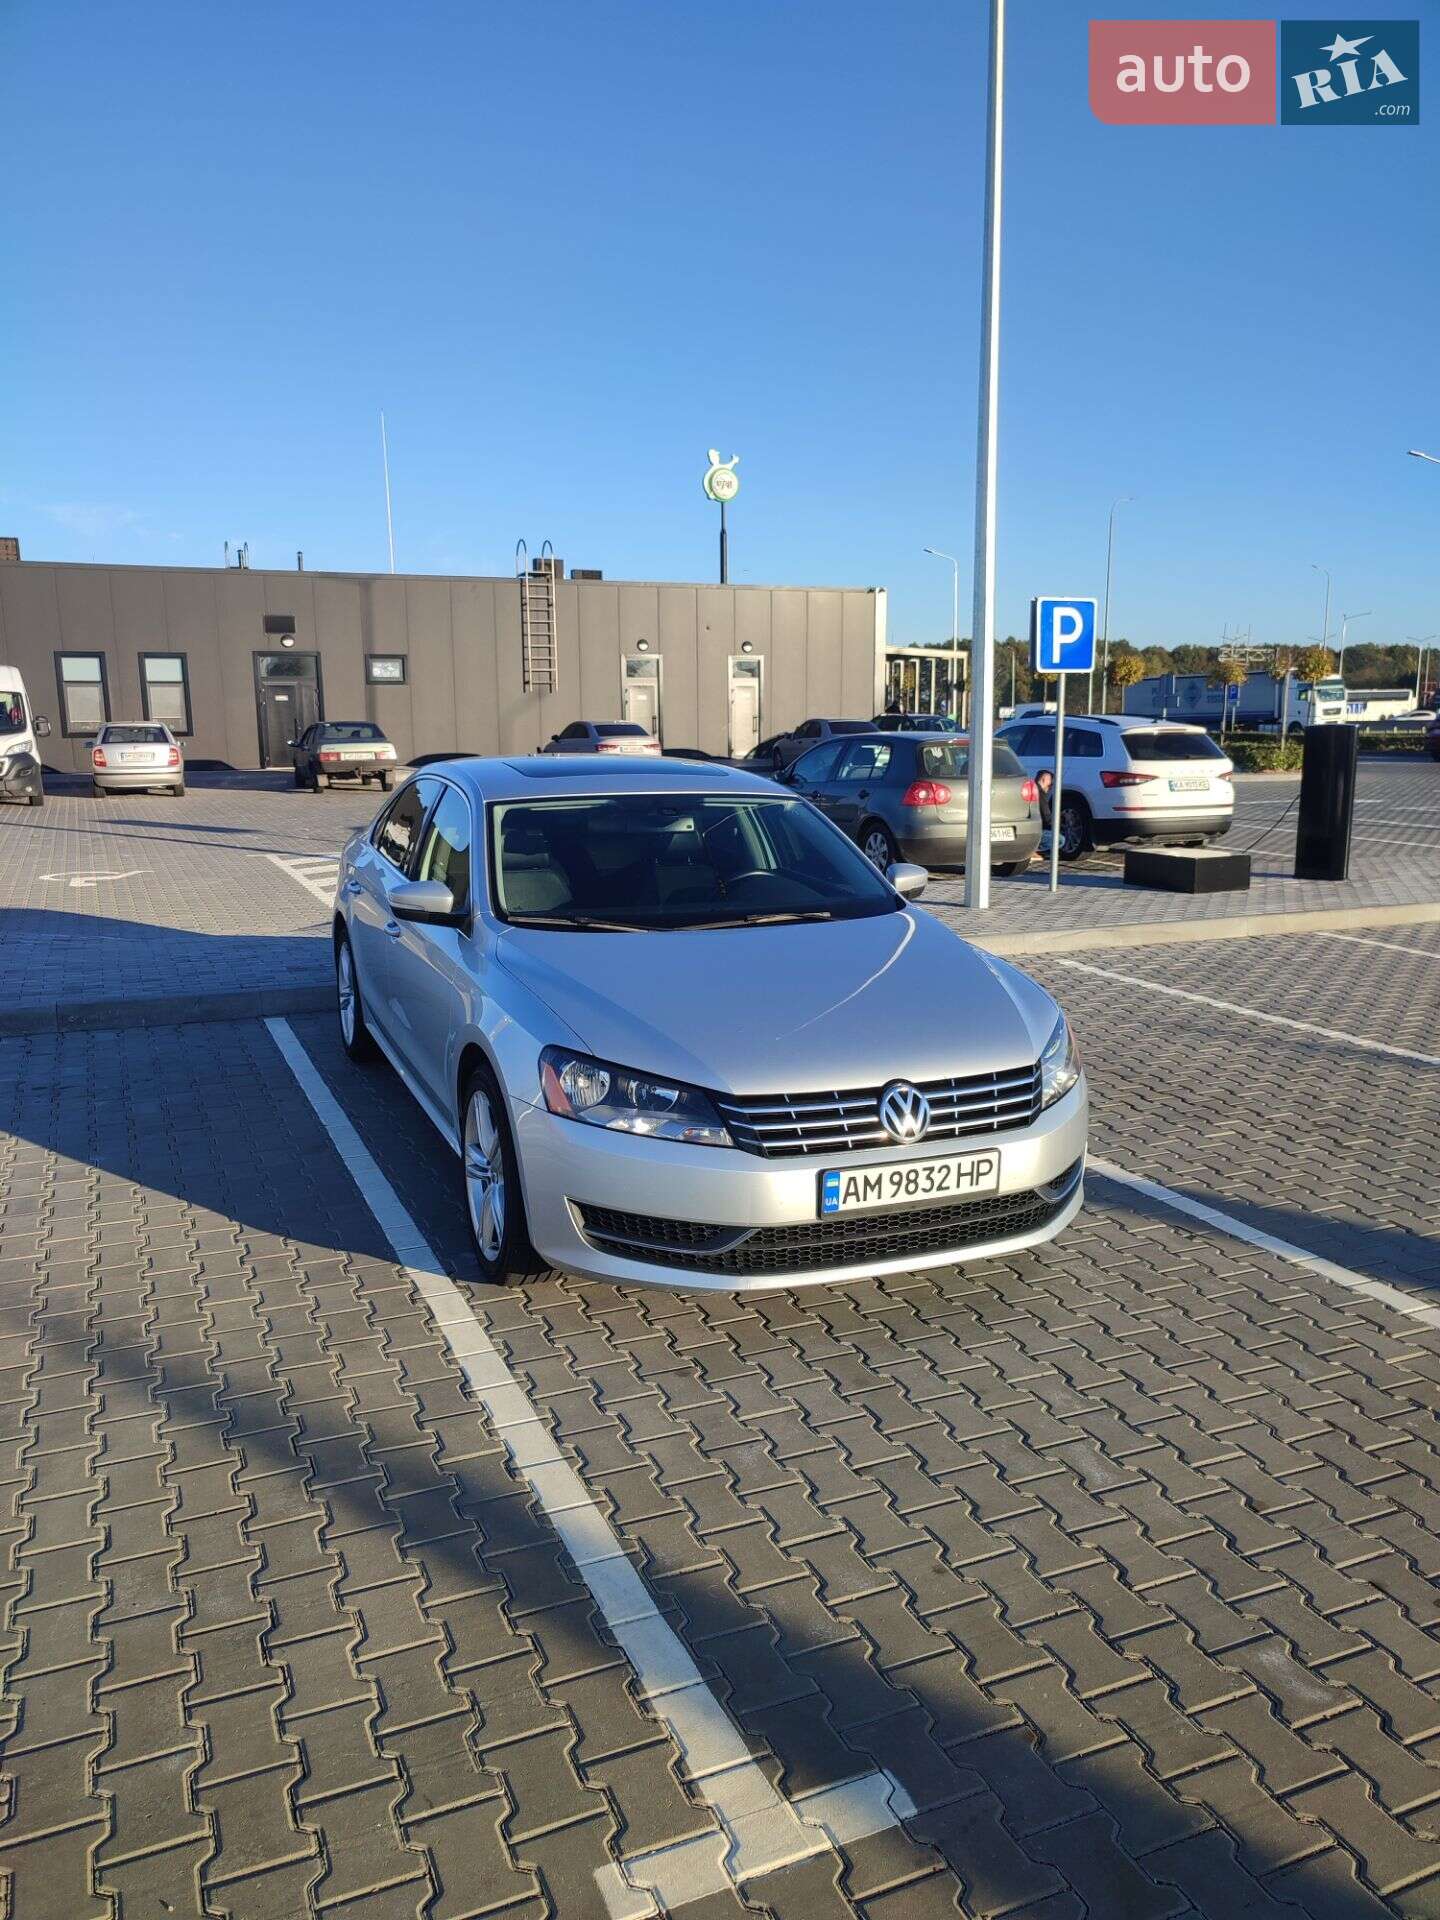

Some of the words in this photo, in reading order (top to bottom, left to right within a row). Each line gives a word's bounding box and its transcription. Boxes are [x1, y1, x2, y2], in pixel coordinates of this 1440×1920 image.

[1052, 606, 1084, 665] P
[825, 1196, 838, 1206] UA
[842, 1173, 883, 1204] AM
[889, 1164, 952, 1198] 9832
[956, 1158, 994, 1189] HP
